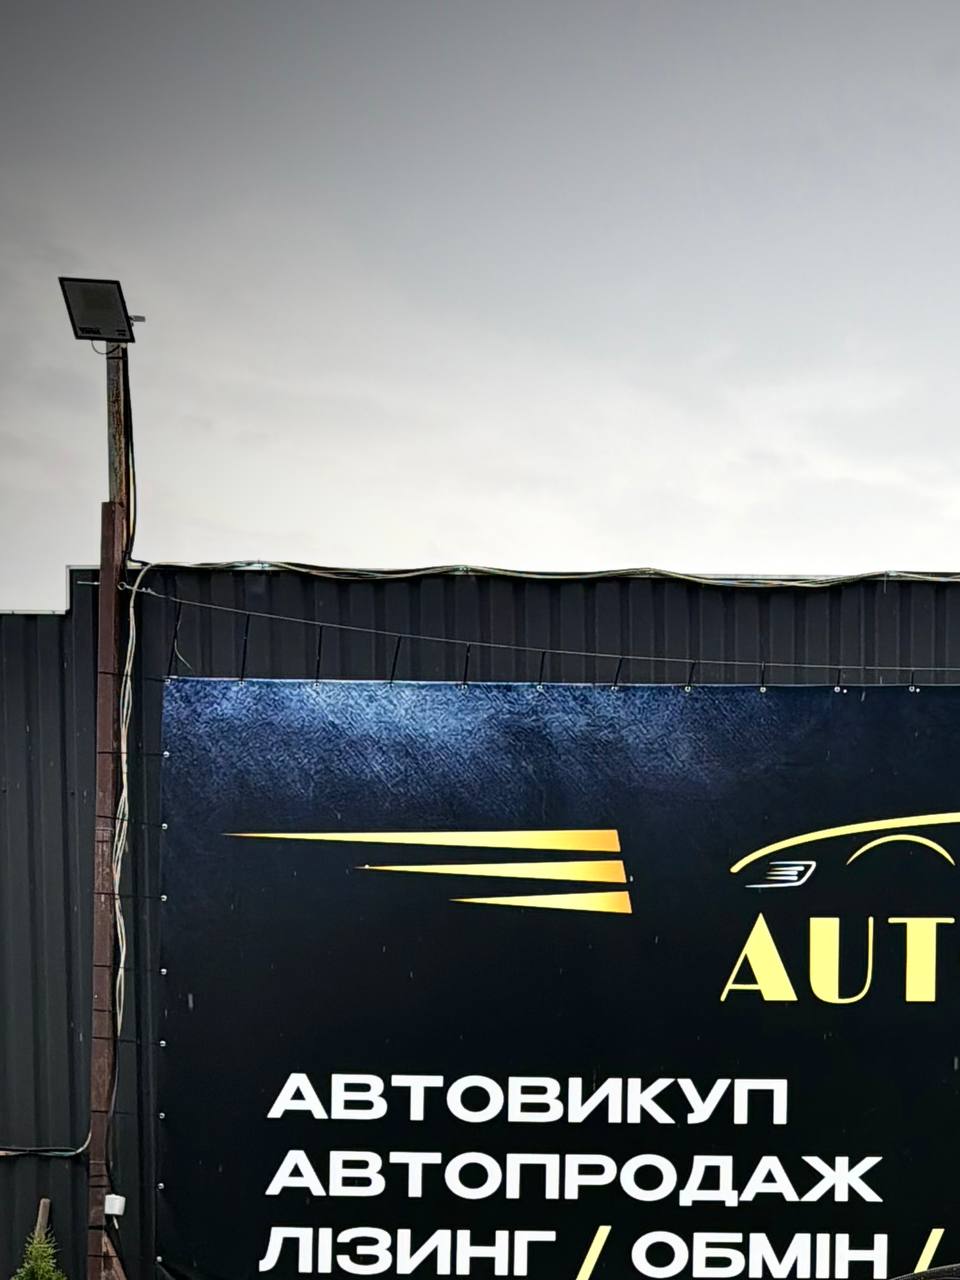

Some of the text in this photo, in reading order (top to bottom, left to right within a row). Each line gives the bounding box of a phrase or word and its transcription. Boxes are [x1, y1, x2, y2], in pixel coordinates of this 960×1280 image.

[267, 1072, 788, 1125] АВТОВИКУП
[265, 1149, 884, 1207] АВТОПРОДАЖ
[258, 1226, 557, 1277] ЛІЗИНГ
[631, 1230, 889, 1280] ОБМІН
